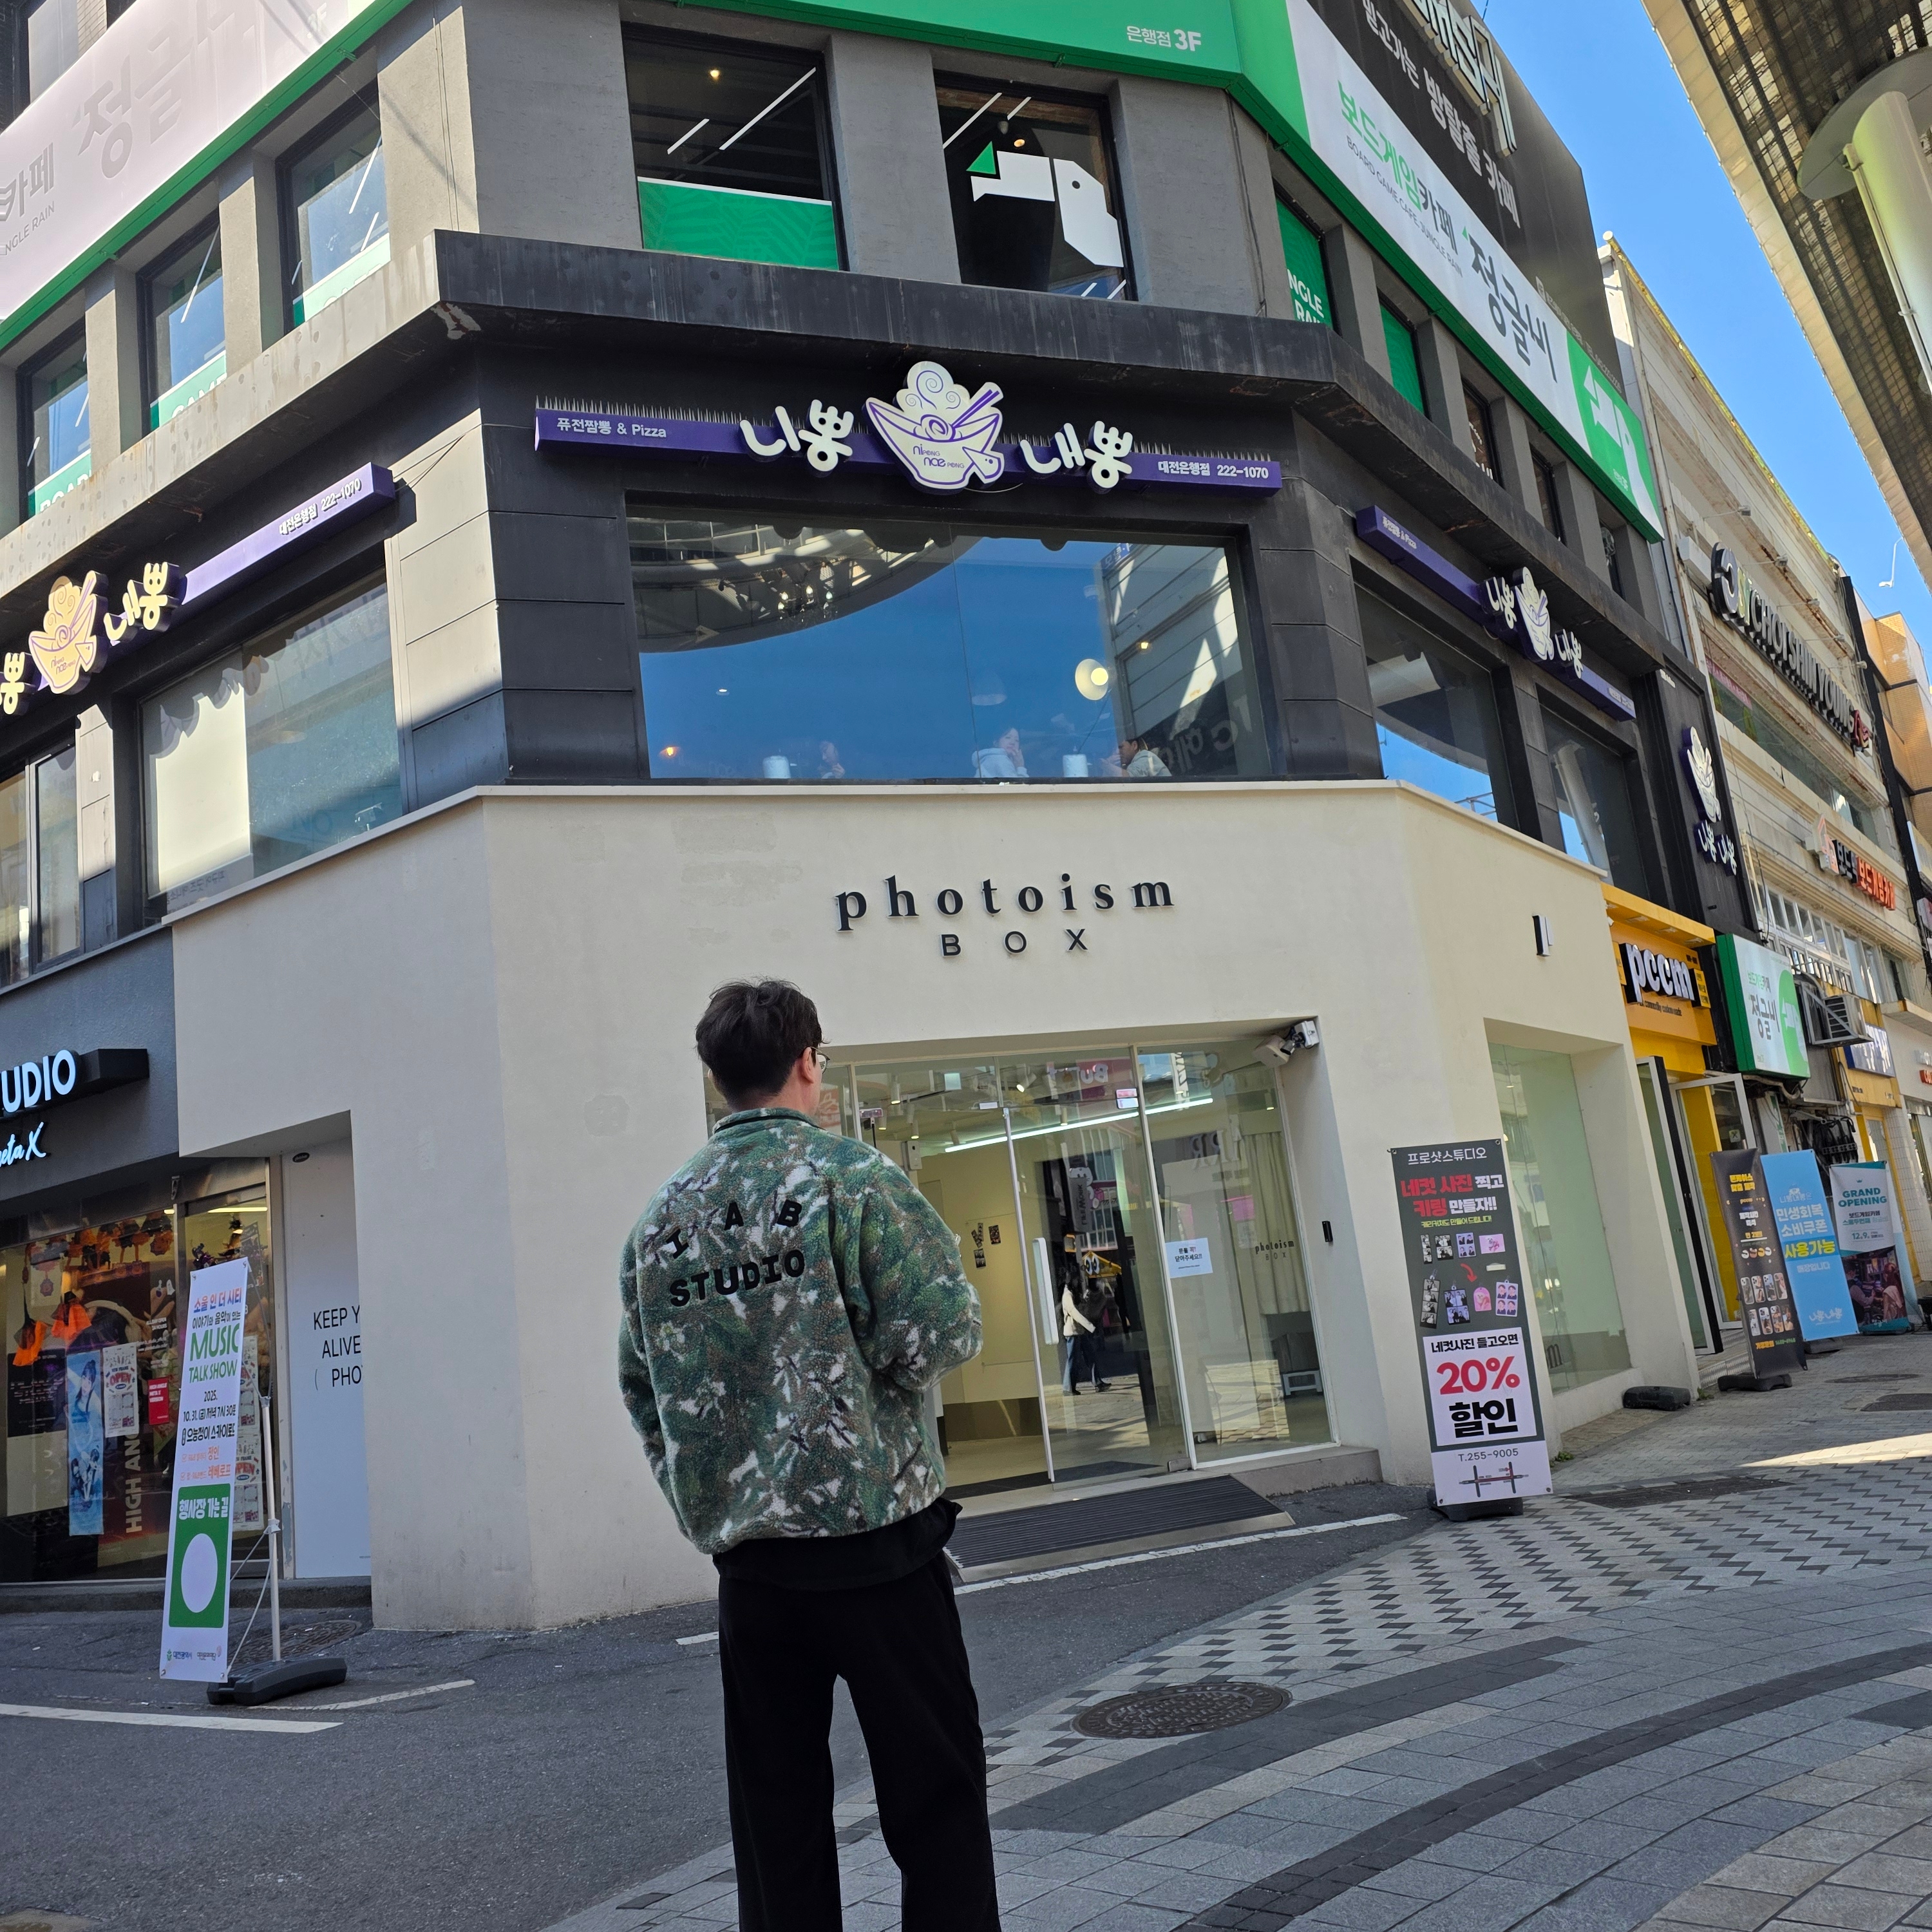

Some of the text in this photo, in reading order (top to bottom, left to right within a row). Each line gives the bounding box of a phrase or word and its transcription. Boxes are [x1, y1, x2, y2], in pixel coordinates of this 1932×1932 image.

[1126, 24, 1202, 53] 은행점 3F
[1423, 67, 1482, 177] 방탈출
[1482, 149, 1520, 229] 카페
[1338, 79, 1458, 256] 보드게임카페
[1347, 135, 1376, 175] BOARD
[1376, 171, 1399, 204] GAME
[32, 200, 55, 232] RAIN
[1287, 269, 1325, 318] NGLE
[1468, 232, 1557, 383] 정글비
[556, 417, 667, 439] 퓨전짬뽕 & Pizza
[739, 399, 855, 472] 니뽕
[1019, 420, 1133, 489] 내뽕
[1157, 460, 1269, 480] 대전은행점 222-1070
[278, 478, 361, 535] 대전은행점 222-1070
[103, 562, 169, 641] 내뽕
[0, 652, 26, 715] 뽕
[835, 873, 1175, 932] photoism
[940, 928, 1088, 957] BOX
[1624, 943, 1695, 1003] pccm
[1749, 994, 1781, 1041] 정글비
[1, 1049, 76, 1113] UDIO
[0, 1133, 25, 1168] eta
[1400, 1173, 1505, 1198] 네컷 사진 찍고
[1842, 1187, 1881, 1198] GRAND
[1412, 1196, 1498, 1218] 키링 만들자!!
[1776, 1203, 1824, 1222] 민생회복
[1838, 1195, 1888, 1208] OPENING
[1781, 1218, 1828, 1237] 소비쿠폰
[1255, 1239, 1294, 1255] photoism
[1784, 1238, 1836, 1259] 사용가능
[668, 1249, 806, 1308] STUDIO
[193, 1287, 243, 1314] 소울 인 더 시티
[192, 1310, 241, 1330] 이야기와 음악이 있는
[313, 1307, 348, 1331] KEEP
[189, 1322, 240, 1362] MUSIC
[321, 1334, 361, 1359] ALIVE
[1430, 1333, 1519, 1354] 네컷사진 들고오면
[189, 1359, 238, 1384] TALK SHOW
[1436, 1356, 1520, 1396] 20%
[204, 1389, 218, 1403] 2025.
[217, 1405, 226, 1418] 7시
[225, 1403, 236, 1417] 30분
[1448, 1397, 1519, 1439] 할인
[186, 1425, 211, 1443] 으능정이
[207, 1445, 220, 1462] 정인
[1457, 1448, 1519, 1463] T.255-9005
[124, 1477, 142, 1534] HIGH
[178, 1496, 229, 1520] 행사장 가는 길
